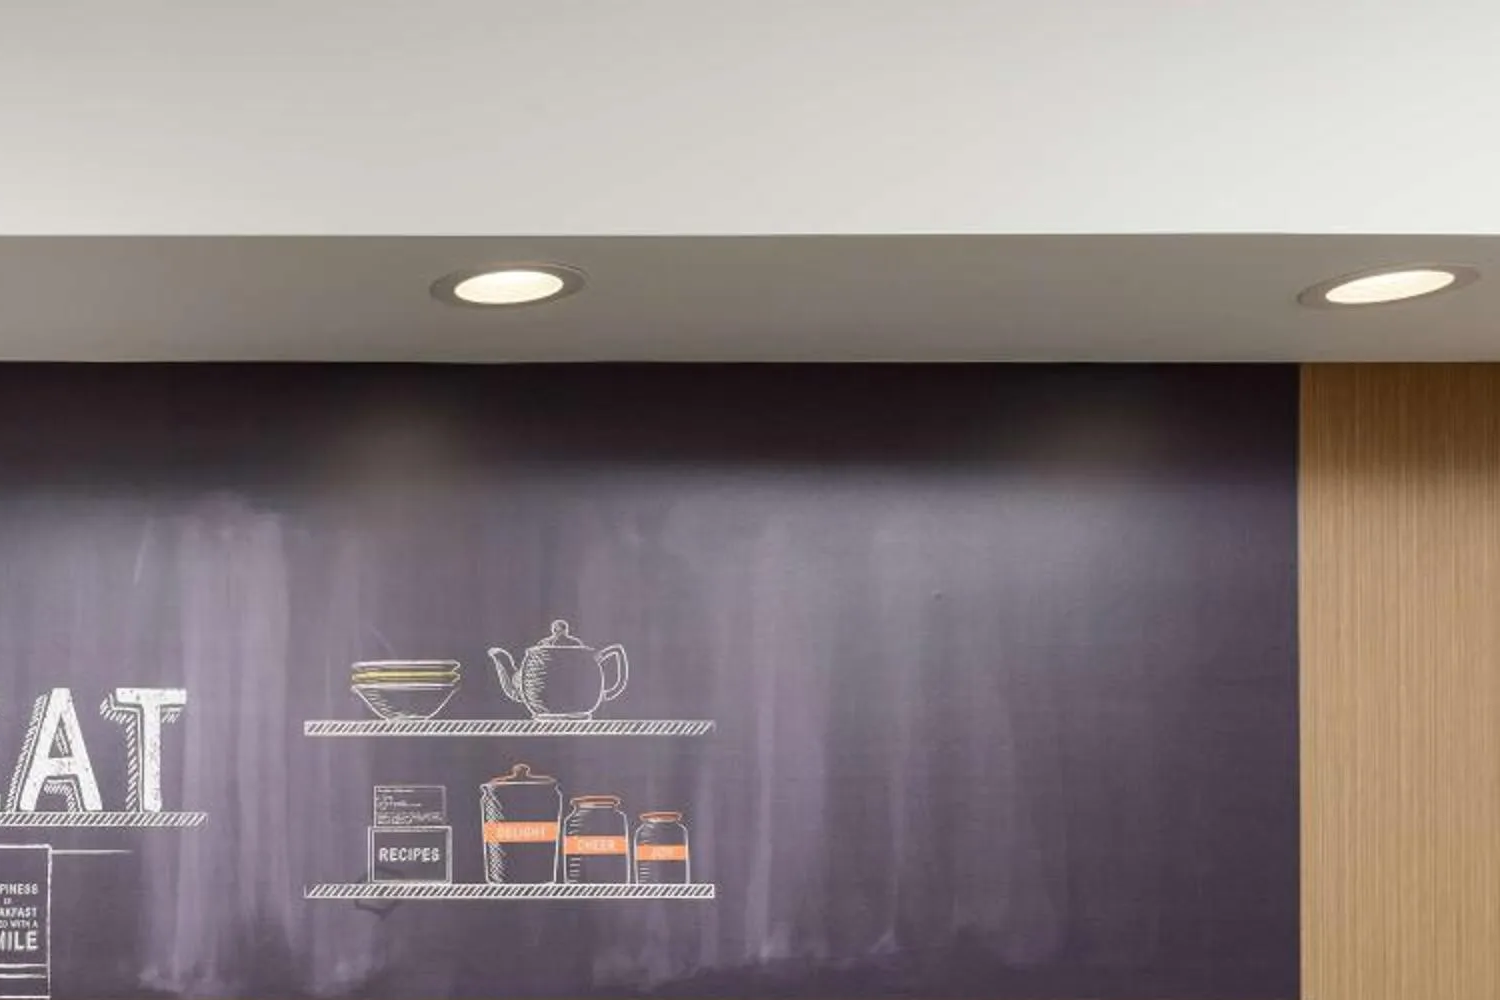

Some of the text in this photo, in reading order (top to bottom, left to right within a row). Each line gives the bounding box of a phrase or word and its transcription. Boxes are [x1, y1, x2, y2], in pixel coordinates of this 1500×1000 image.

[379, 847, 440, 862] RECIPES
[10, 919, 31, 929] WITH
[32, 920, 39, 929] A
